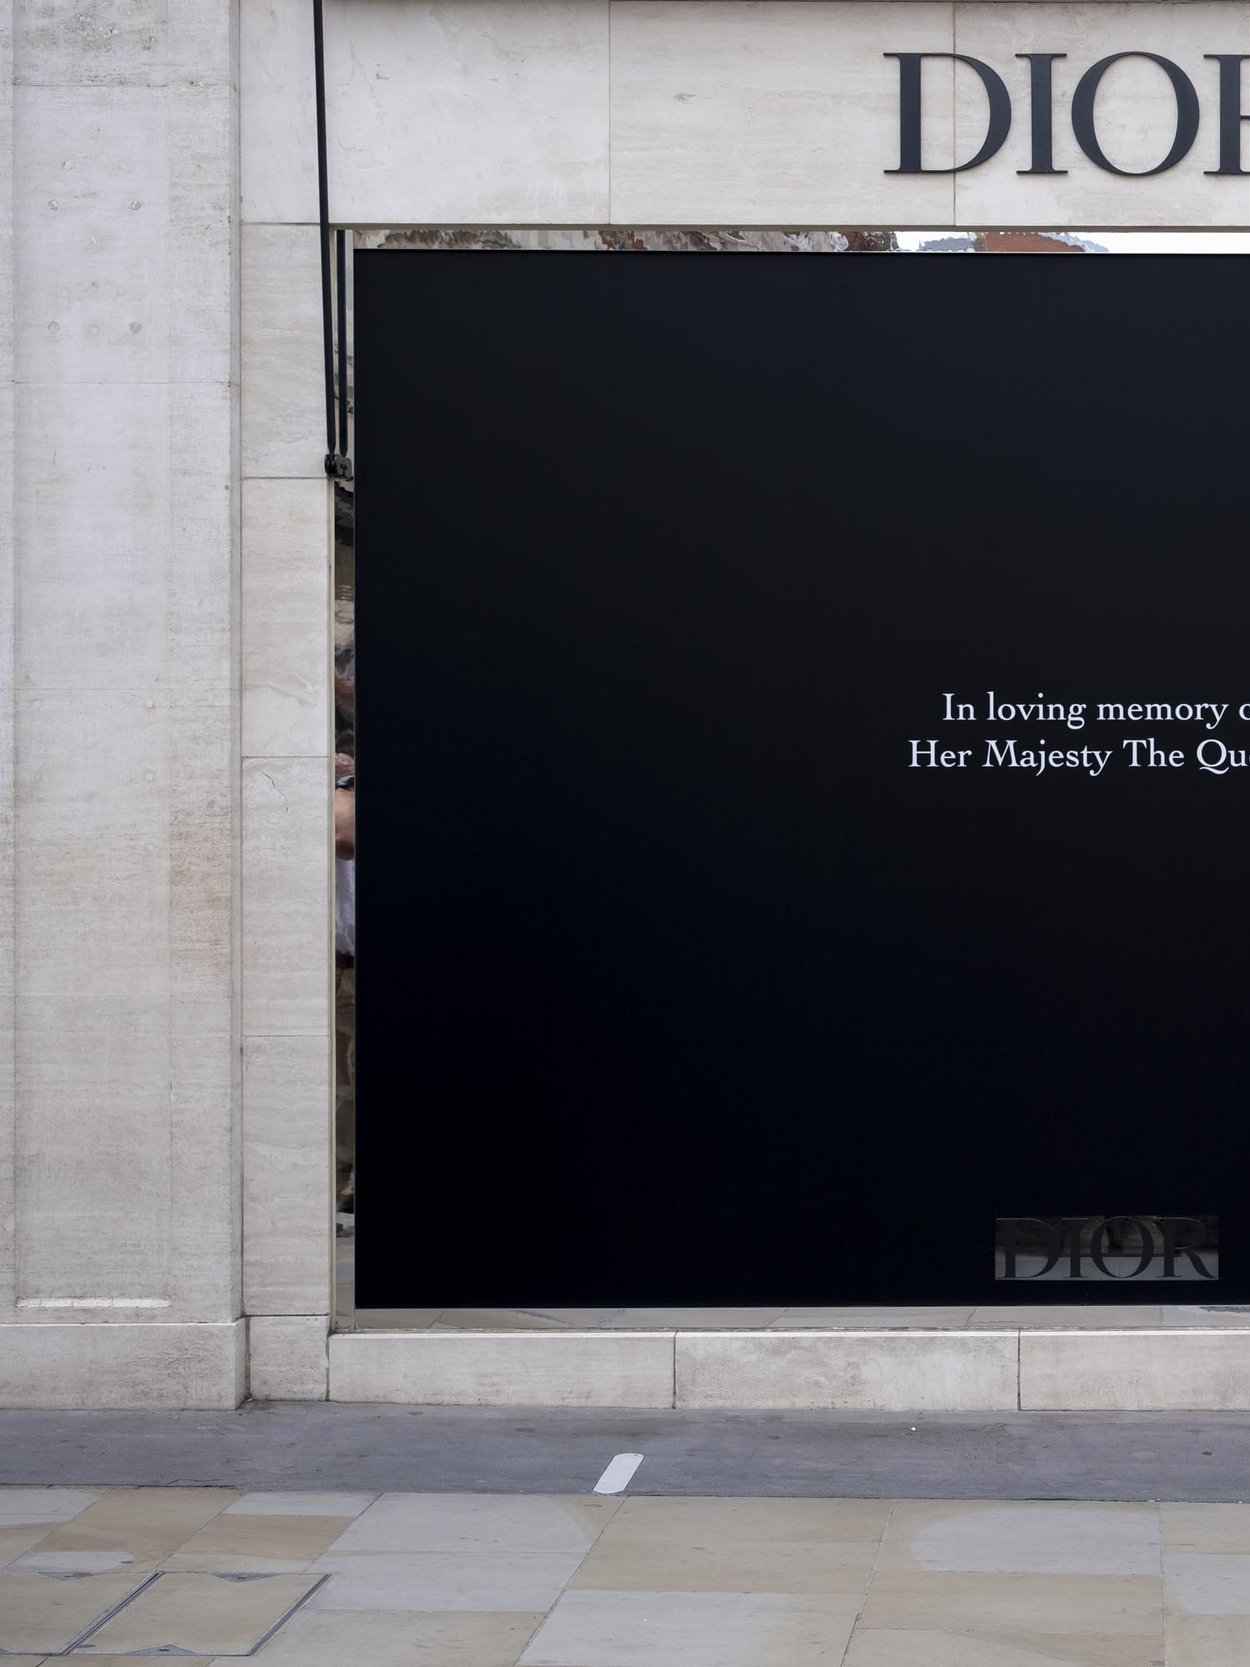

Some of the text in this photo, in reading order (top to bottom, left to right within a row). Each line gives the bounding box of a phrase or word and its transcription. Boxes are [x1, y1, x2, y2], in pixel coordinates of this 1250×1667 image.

[942, 692, 977, 721] In
[986, 690, 1087, 730] loving
[1096, 702, 1230, 730] memory
[908, 739, 973, 768] Her
[981, 738, 1113, 777] Majesty
[1122, 737, 1185, 768] The
[996, 1217, 1219, 1279] DIOR
